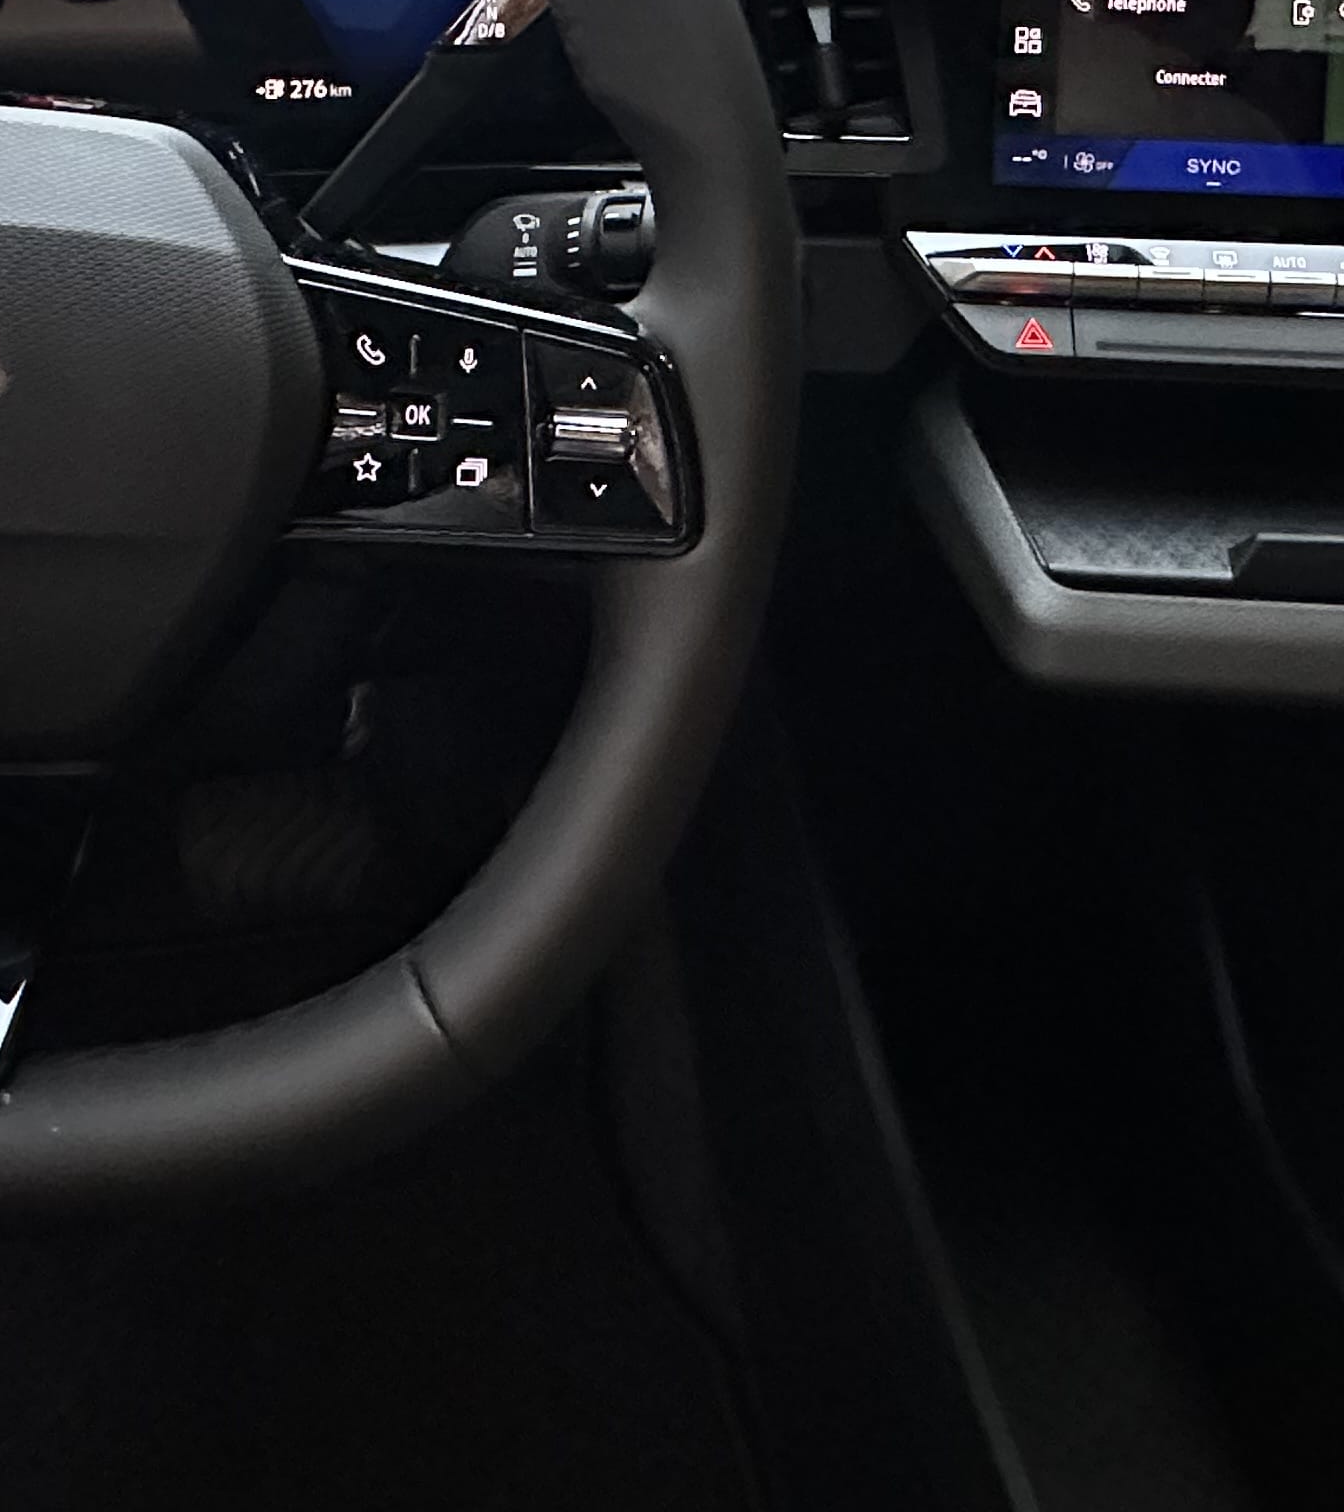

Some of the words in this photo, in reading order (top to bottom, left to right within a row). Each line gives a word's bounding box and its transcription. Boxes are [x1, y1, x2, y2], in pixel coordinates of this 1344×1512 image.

[486, 6, 498, 21] N
[1155, 69, 1227, 86] Connecter
[290, 79, 327, 99] 276
[330, 83, 352, 97] km
[1186, 158, 1241, 176] SYNC
[1272, 255, 1307, 269] AUTO
[404, 404, 432, 426] OK
